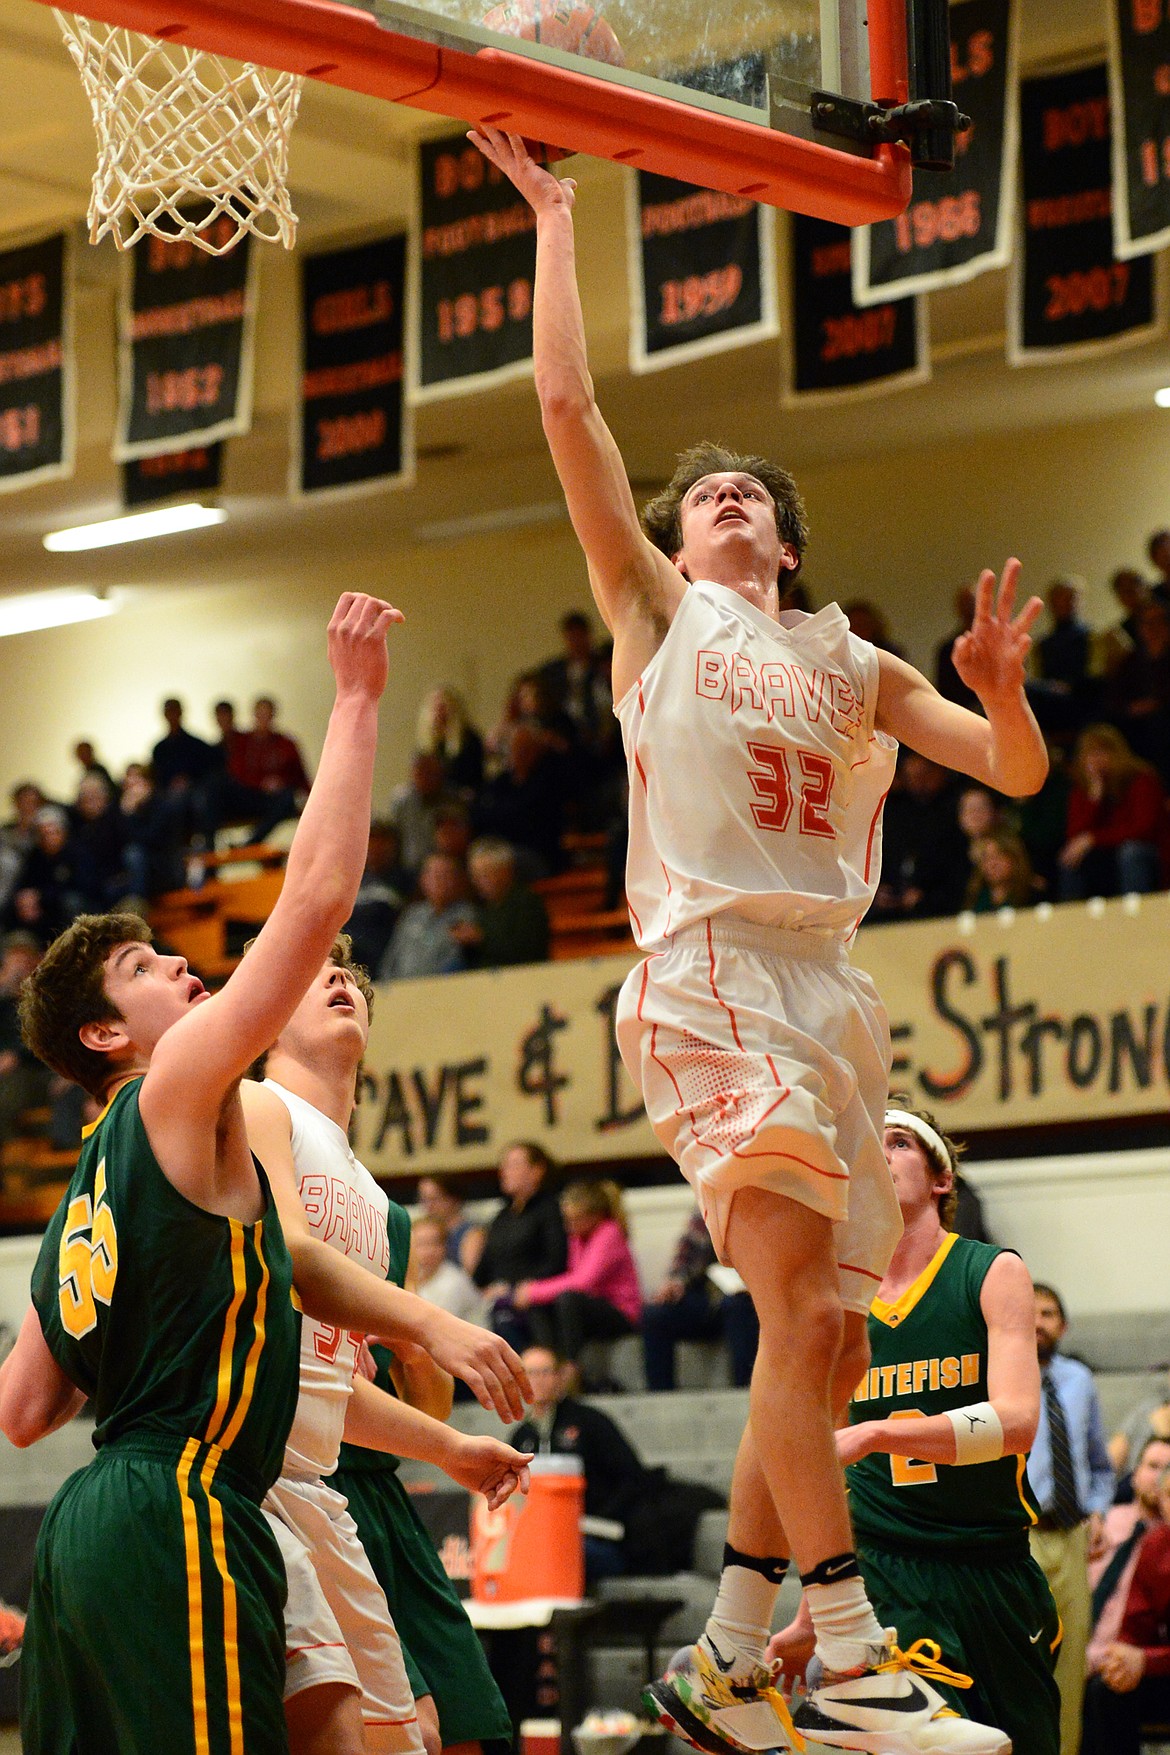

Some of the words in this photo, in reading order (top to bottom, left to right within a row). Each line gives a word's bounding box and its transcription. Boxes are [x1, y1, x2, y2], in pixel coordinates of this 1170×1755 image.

[746, 741, 837, 840] 32
[58, 1156, 119, 1341] 55
[849, 1352, 981, 1404] HITEFISH
